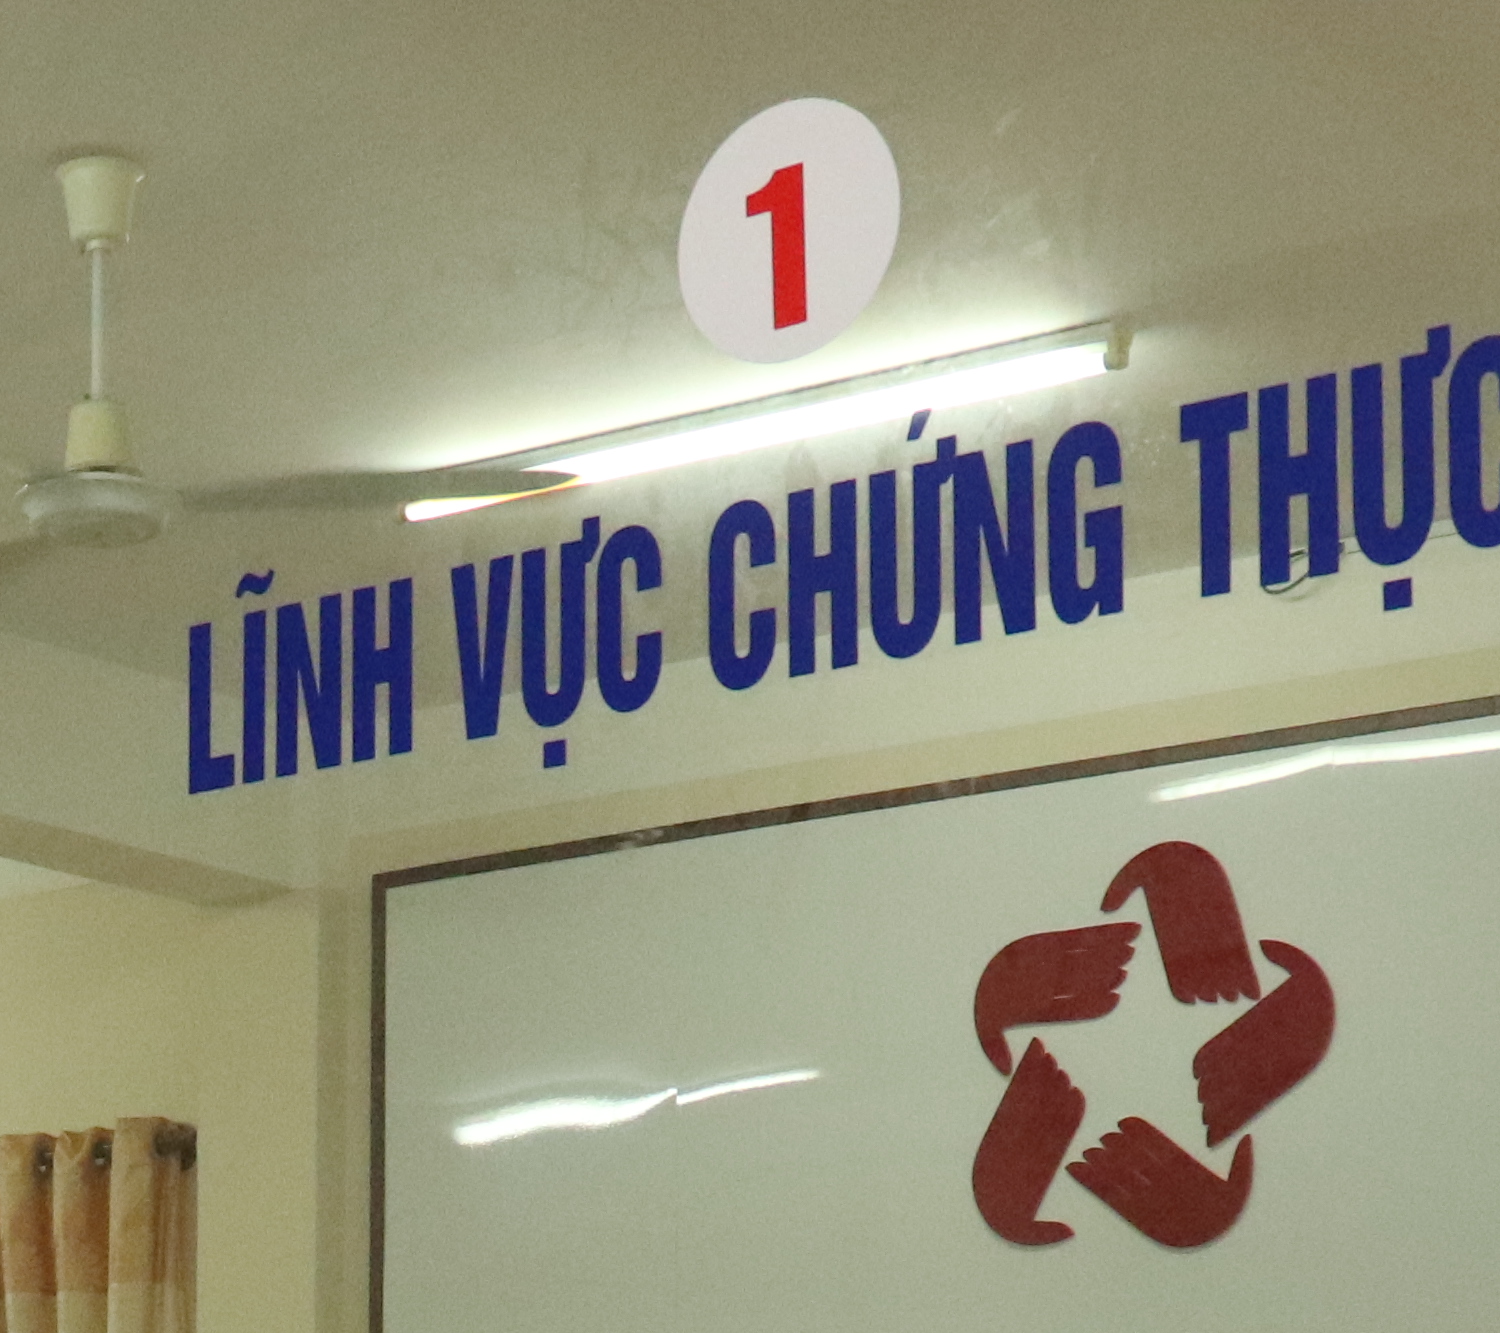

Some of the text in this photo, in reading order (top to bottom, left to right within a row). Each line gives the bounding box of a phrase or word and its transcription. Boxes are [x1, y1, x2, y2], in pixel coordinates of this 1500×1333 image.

[744, 161, 810, 331] 1
[188, 570, 414, 795] LĨNH
[451, 515, 663, 769] VỰC
[708, 411, 1124, 691] CHỨNG
